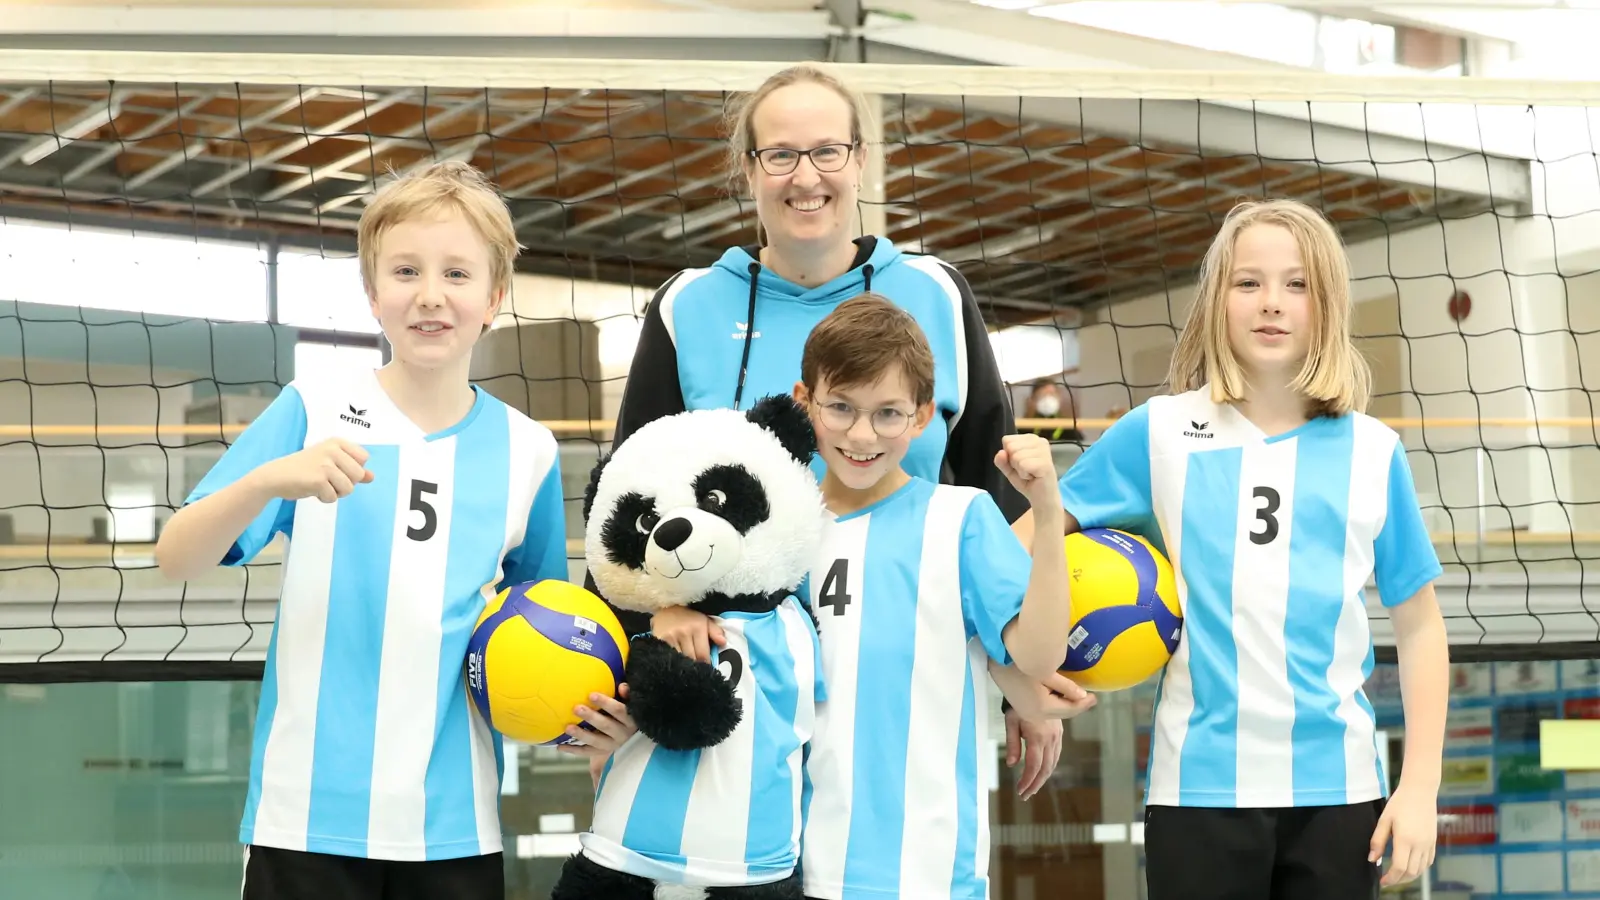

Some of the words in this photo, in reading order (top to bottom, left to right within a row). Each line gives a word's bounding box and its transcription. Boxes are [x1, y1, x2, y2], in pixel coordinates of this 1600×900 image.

[731, 331, 761, 340] eria
[339, 413, 371, 429] erima
[1183, 430, 1214, 439] erima
[406, 478, 438, 542] 5
[1249, 486, 1281, 545] 3
[818, 558, 852, 616] 4
[469, 652, 477, 688] FIVB
